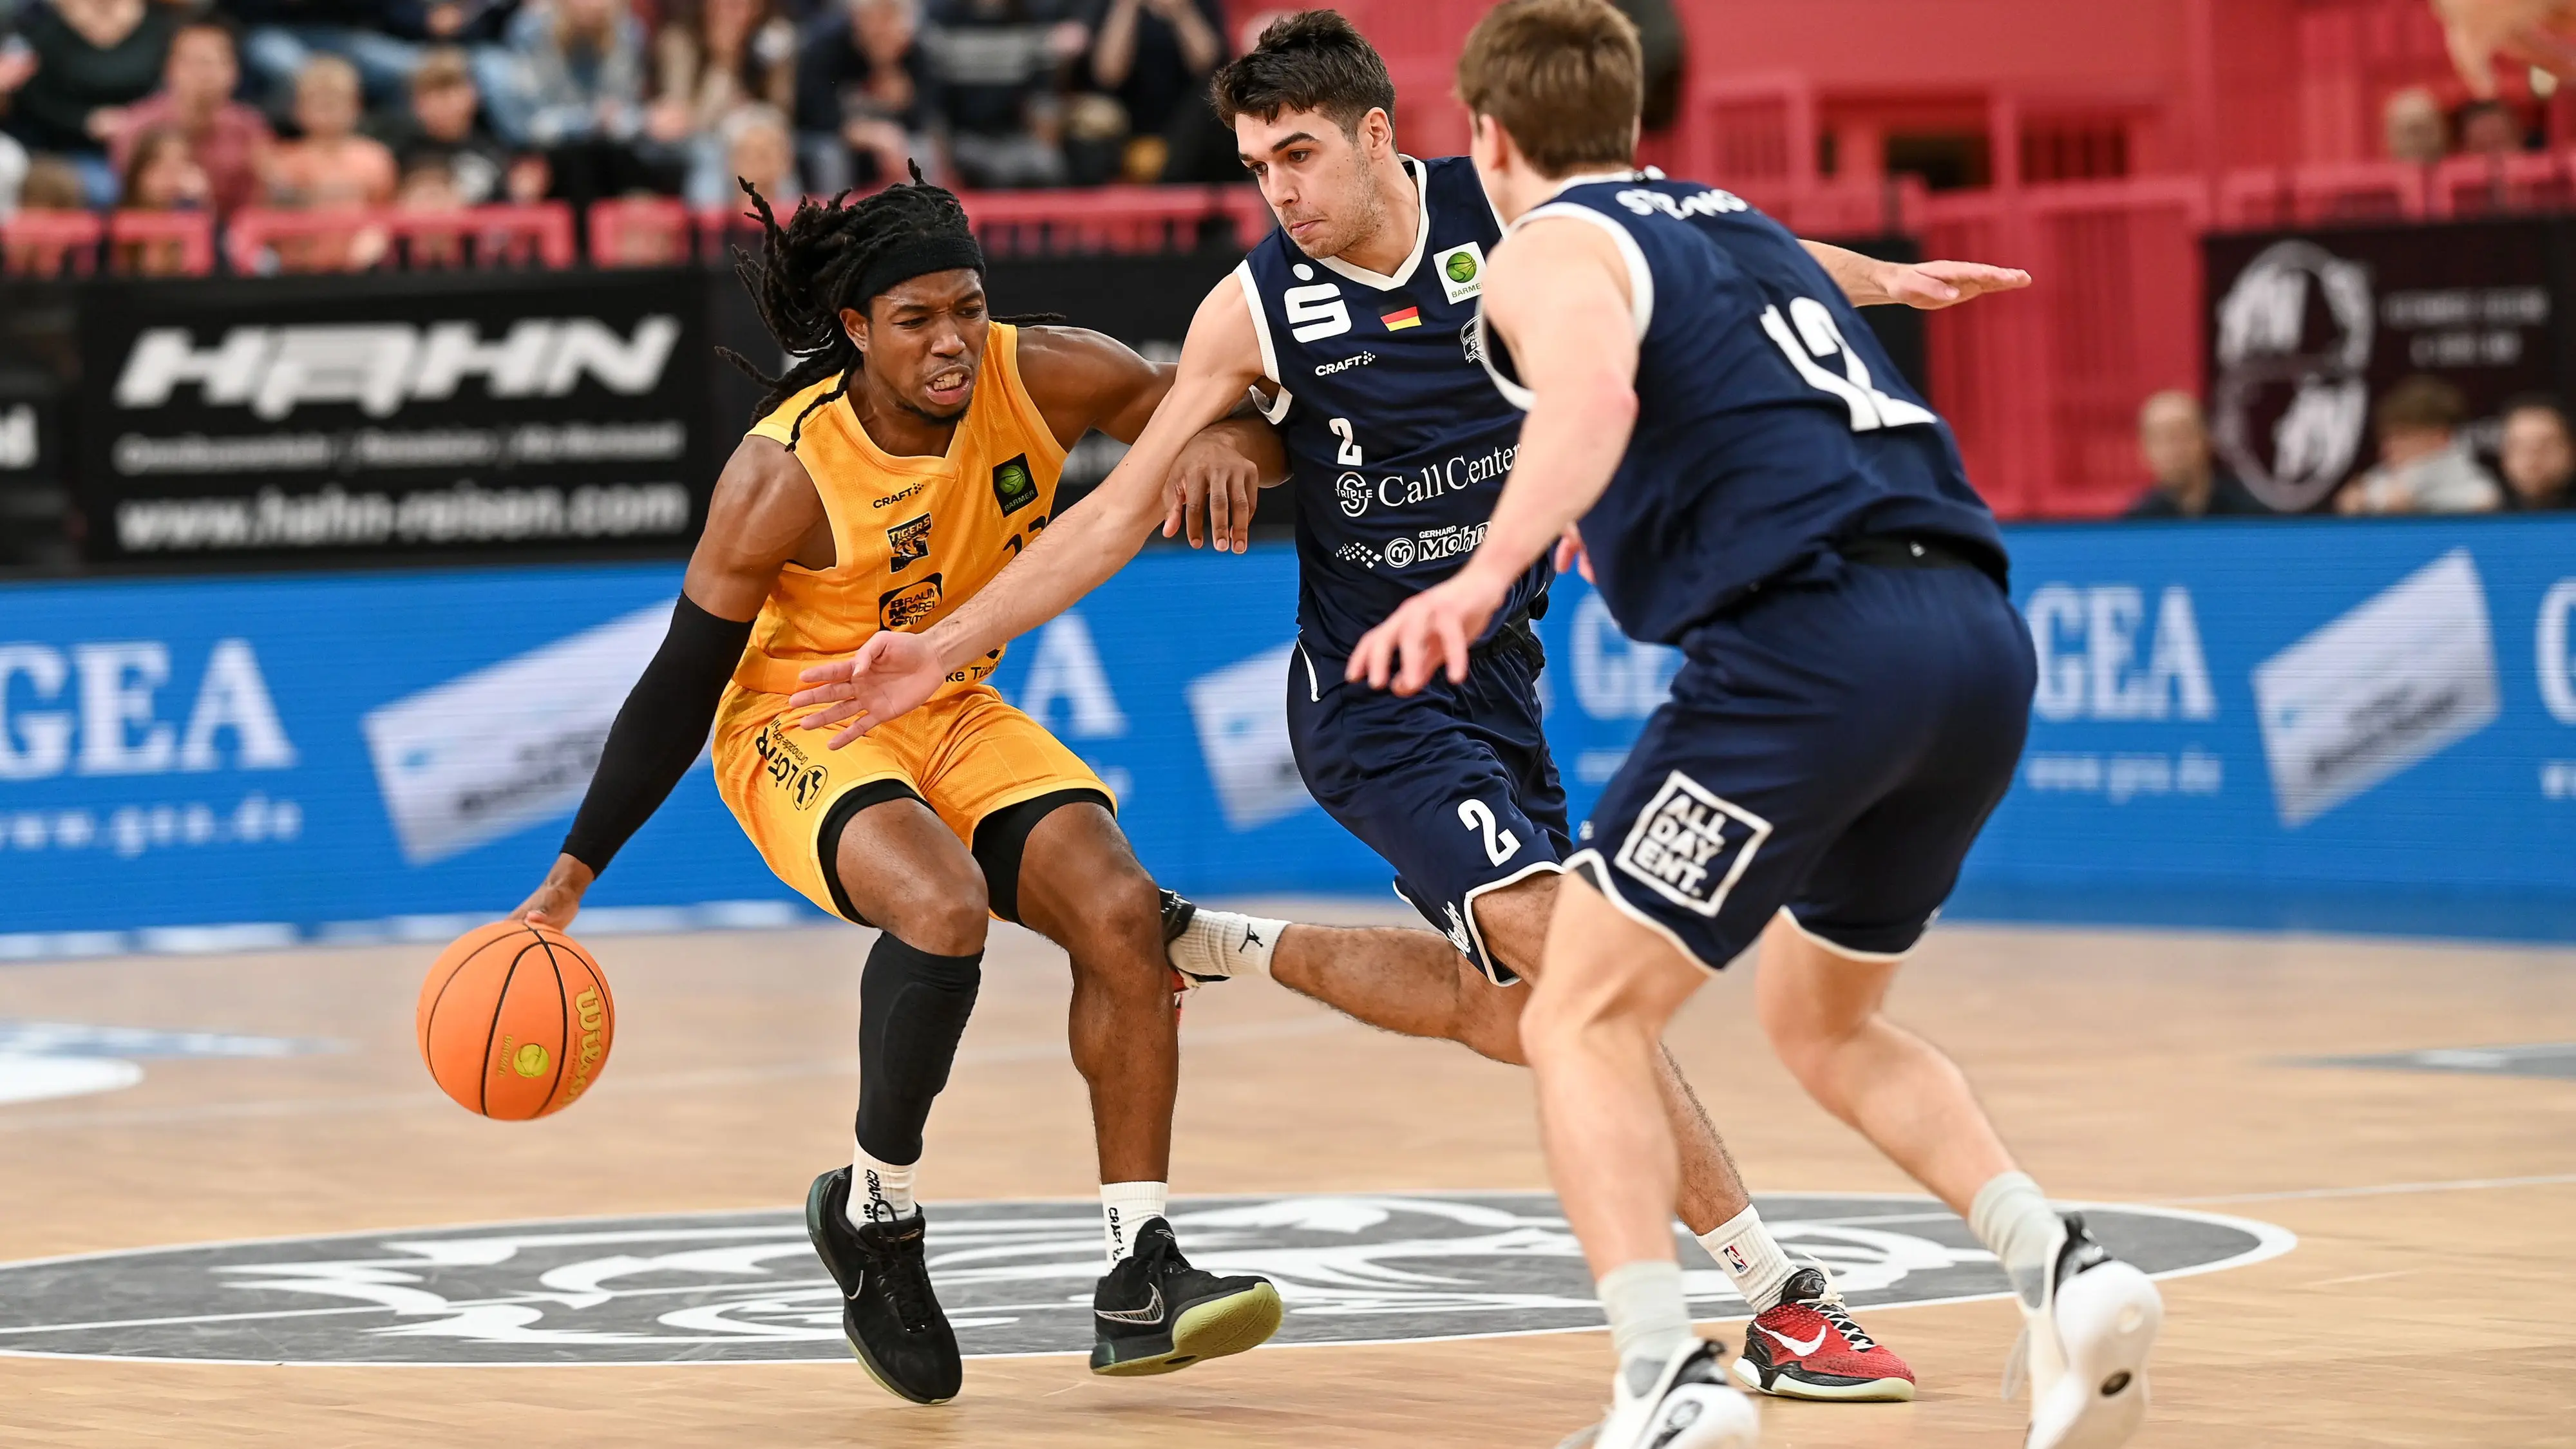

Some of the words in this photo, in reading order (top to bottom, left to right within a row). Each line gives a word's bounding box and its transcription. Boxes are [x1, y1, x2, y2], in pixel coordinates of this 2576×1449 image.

[1452, 282, 1483, 298] BARME
[115, 314, 680, 420] HAHN
[1315, 354, 1362, 376] CRAFT
[1329, 417, 1362, 466] 2
[873, 487, 912, 509] CRAFT
[1004, 489, 1034, 512] BARMER
[1335, 488, 1373, 500] TRIPLE
[1378, 464, 1444, 507] Call
[889, 516, 931, 542] TIGERS
[1419, 525, 1457, 538] GERHARD
[891, 587, 936, 609] BRAUN
[2026, 583, 2217, 722] GEA
[0, 638, 299, 780] GEA
[1457, 799, 1520, 867] 2
[1648, 814, 1723, 866] DAY
[1663, 793, 1726, 847] ALL
[1633, 837, 1708, 898] ENT.
